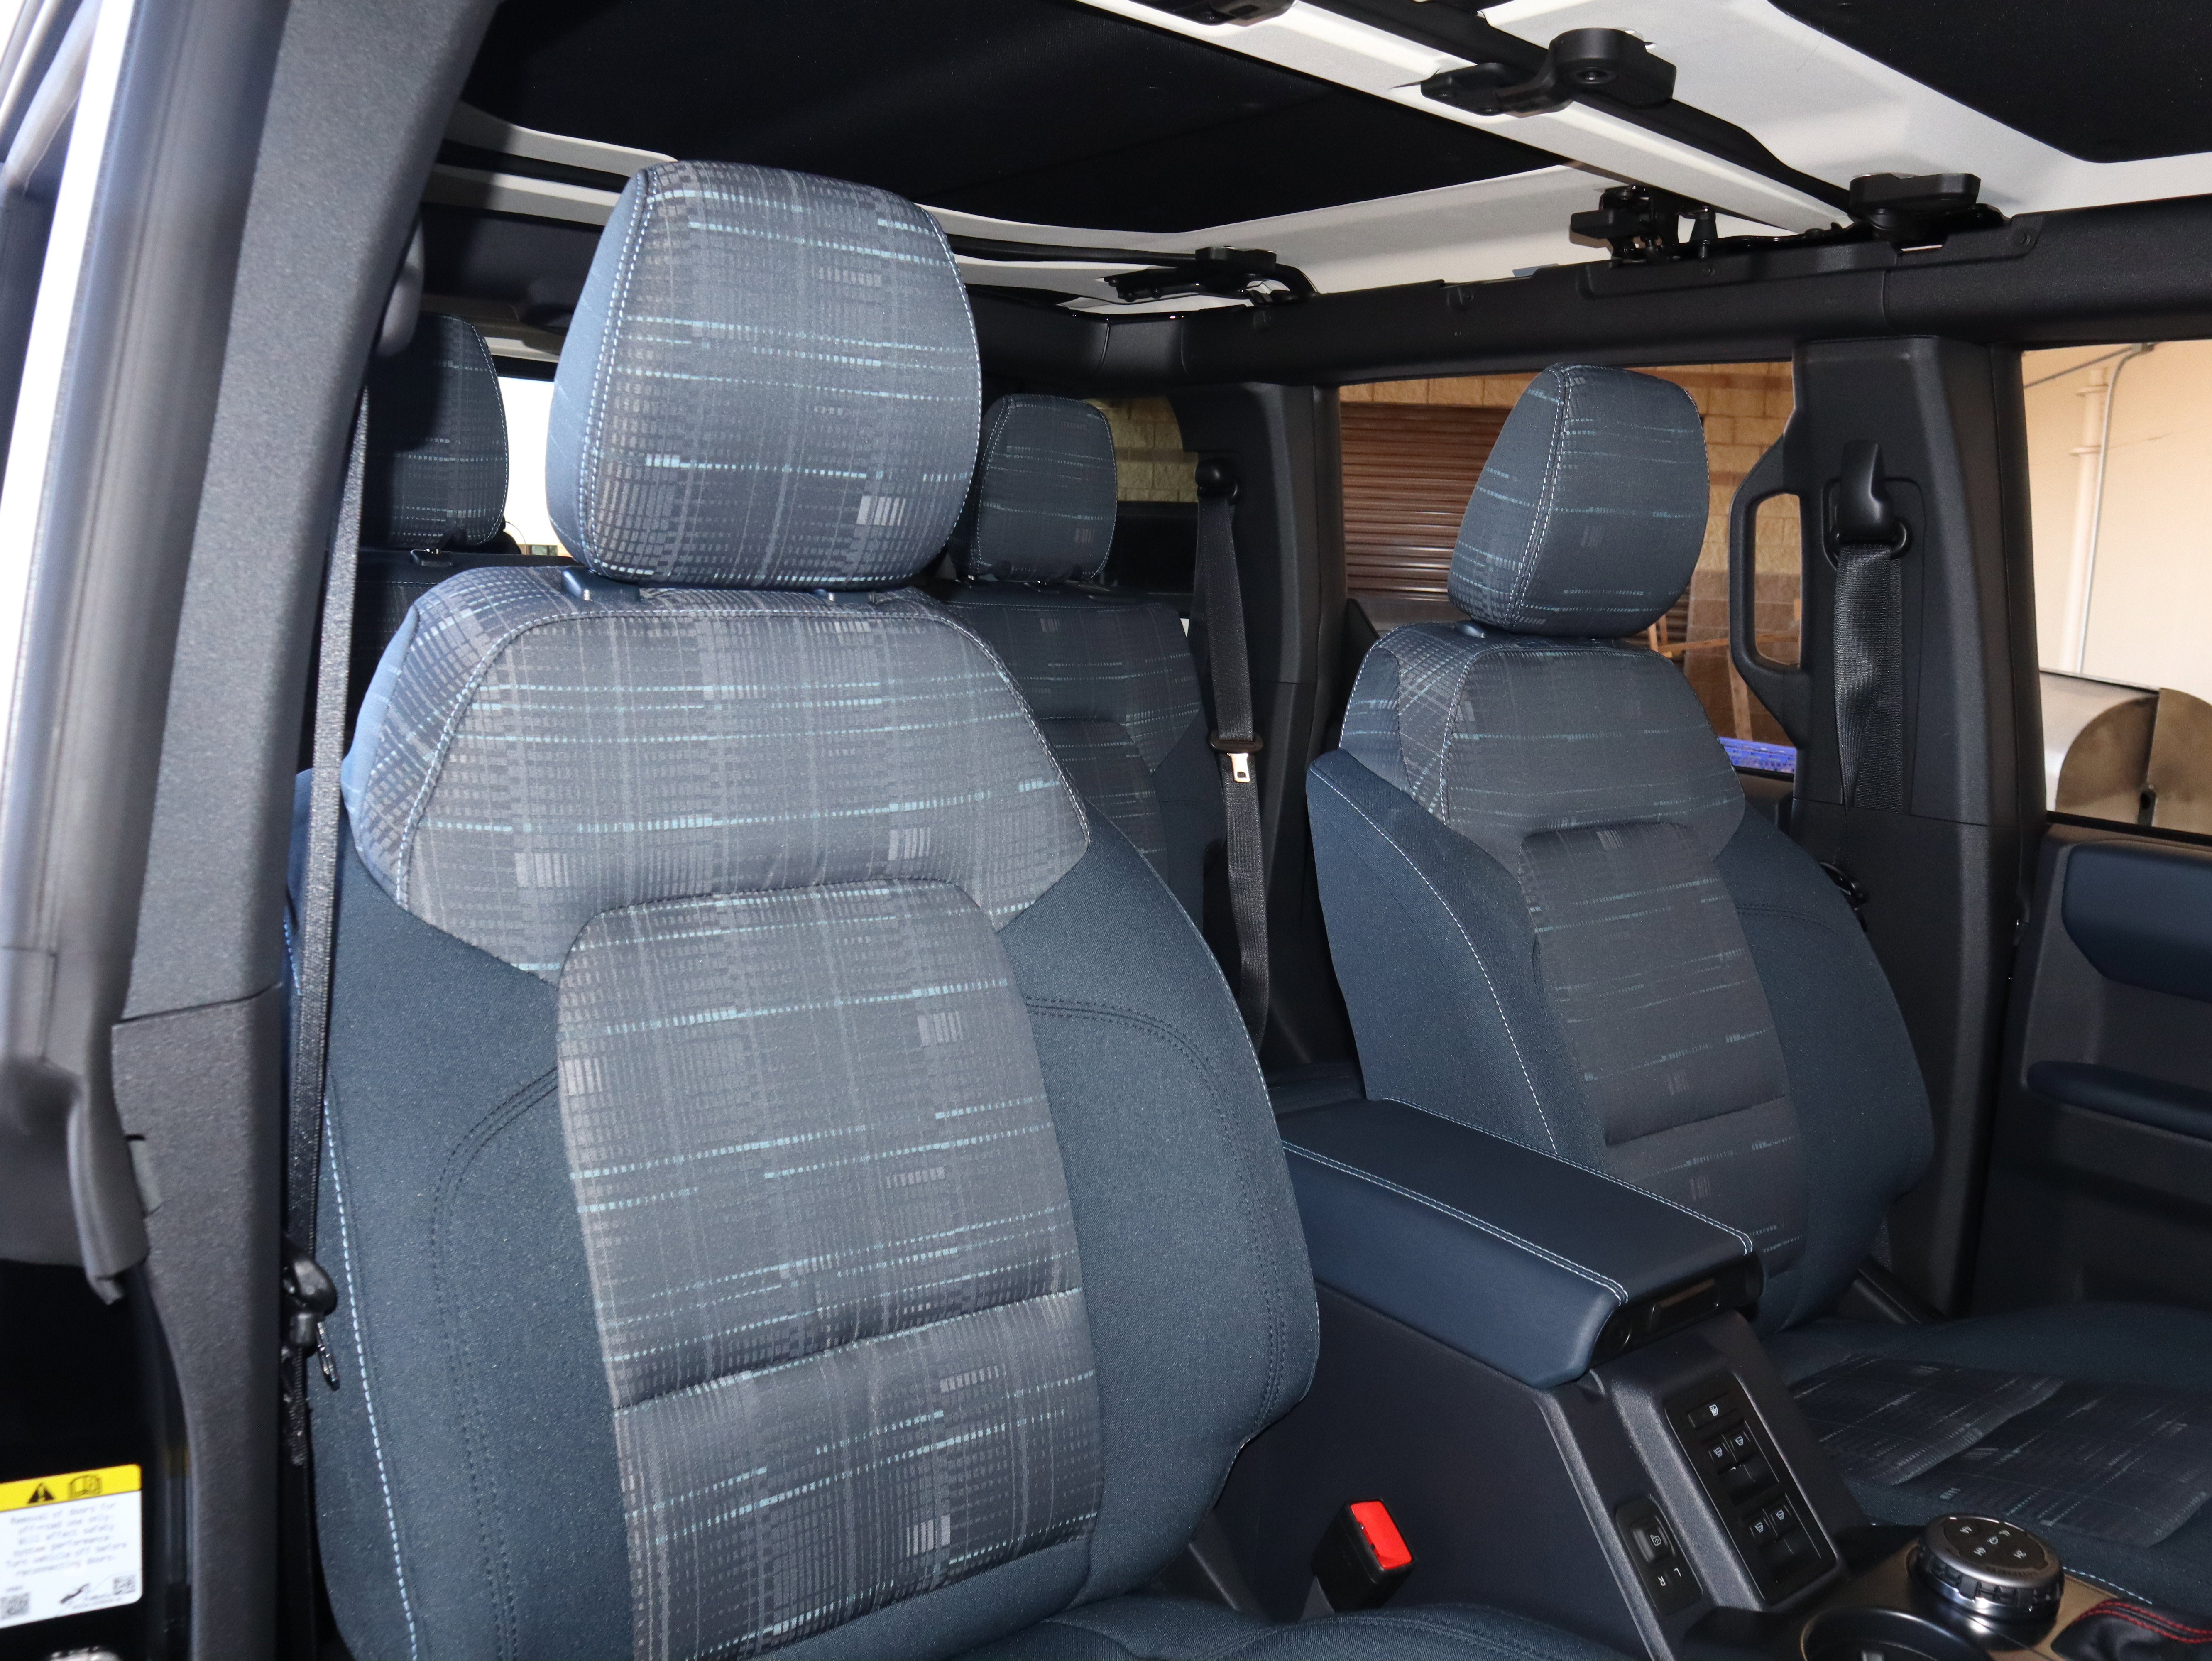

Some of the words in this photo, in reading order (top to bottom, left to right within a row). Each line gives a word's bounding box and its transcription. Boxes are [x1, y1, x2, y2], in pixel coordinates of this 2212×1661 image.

[1974, 1546, 1986, 1556] 4H
[1674, 1568, 1681, 1577] L
[1658, 1575, 1666, 1586] R
